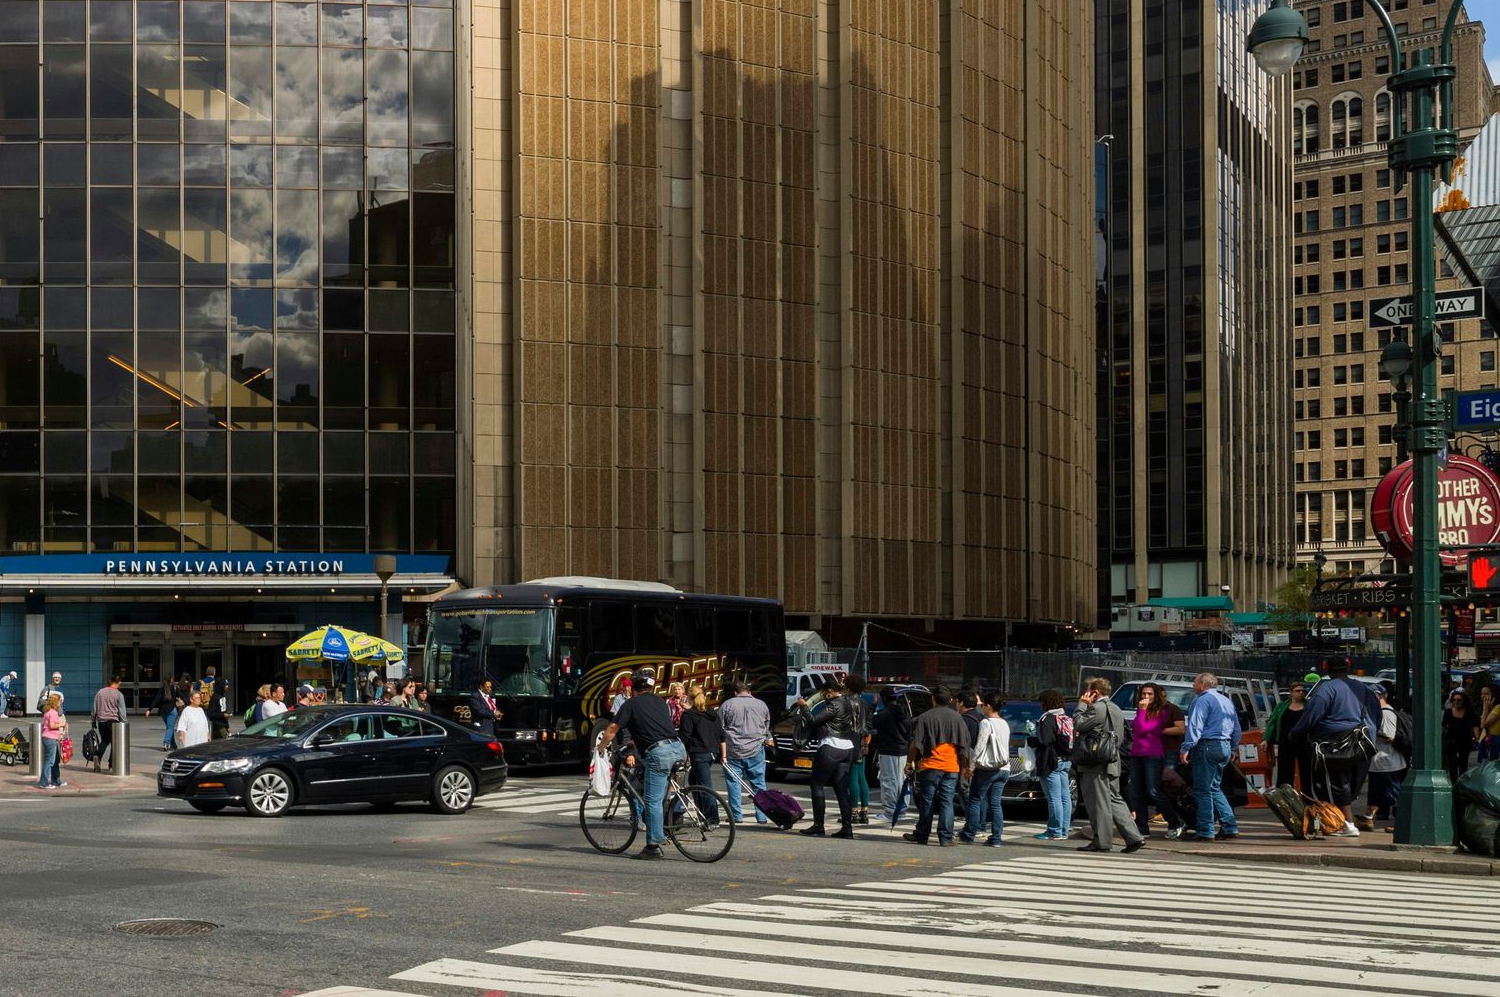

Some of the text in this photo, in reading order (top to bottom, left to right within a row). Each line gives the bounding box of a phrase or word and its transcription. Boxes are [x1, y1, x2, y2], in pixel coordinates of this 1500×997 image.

[1435, 298, 1467, 313] WAY
[1437, 477, 1481, 499] OTHER
[106, 560, 344, 572] PENNSYLVANIA STATION
[1361, 589, 1396, 604] RIBS
[288, 648, 320, 656] SABRETT
[353, 644, 379, 658] SABRETT
[453, 705, 470, 713] GO
